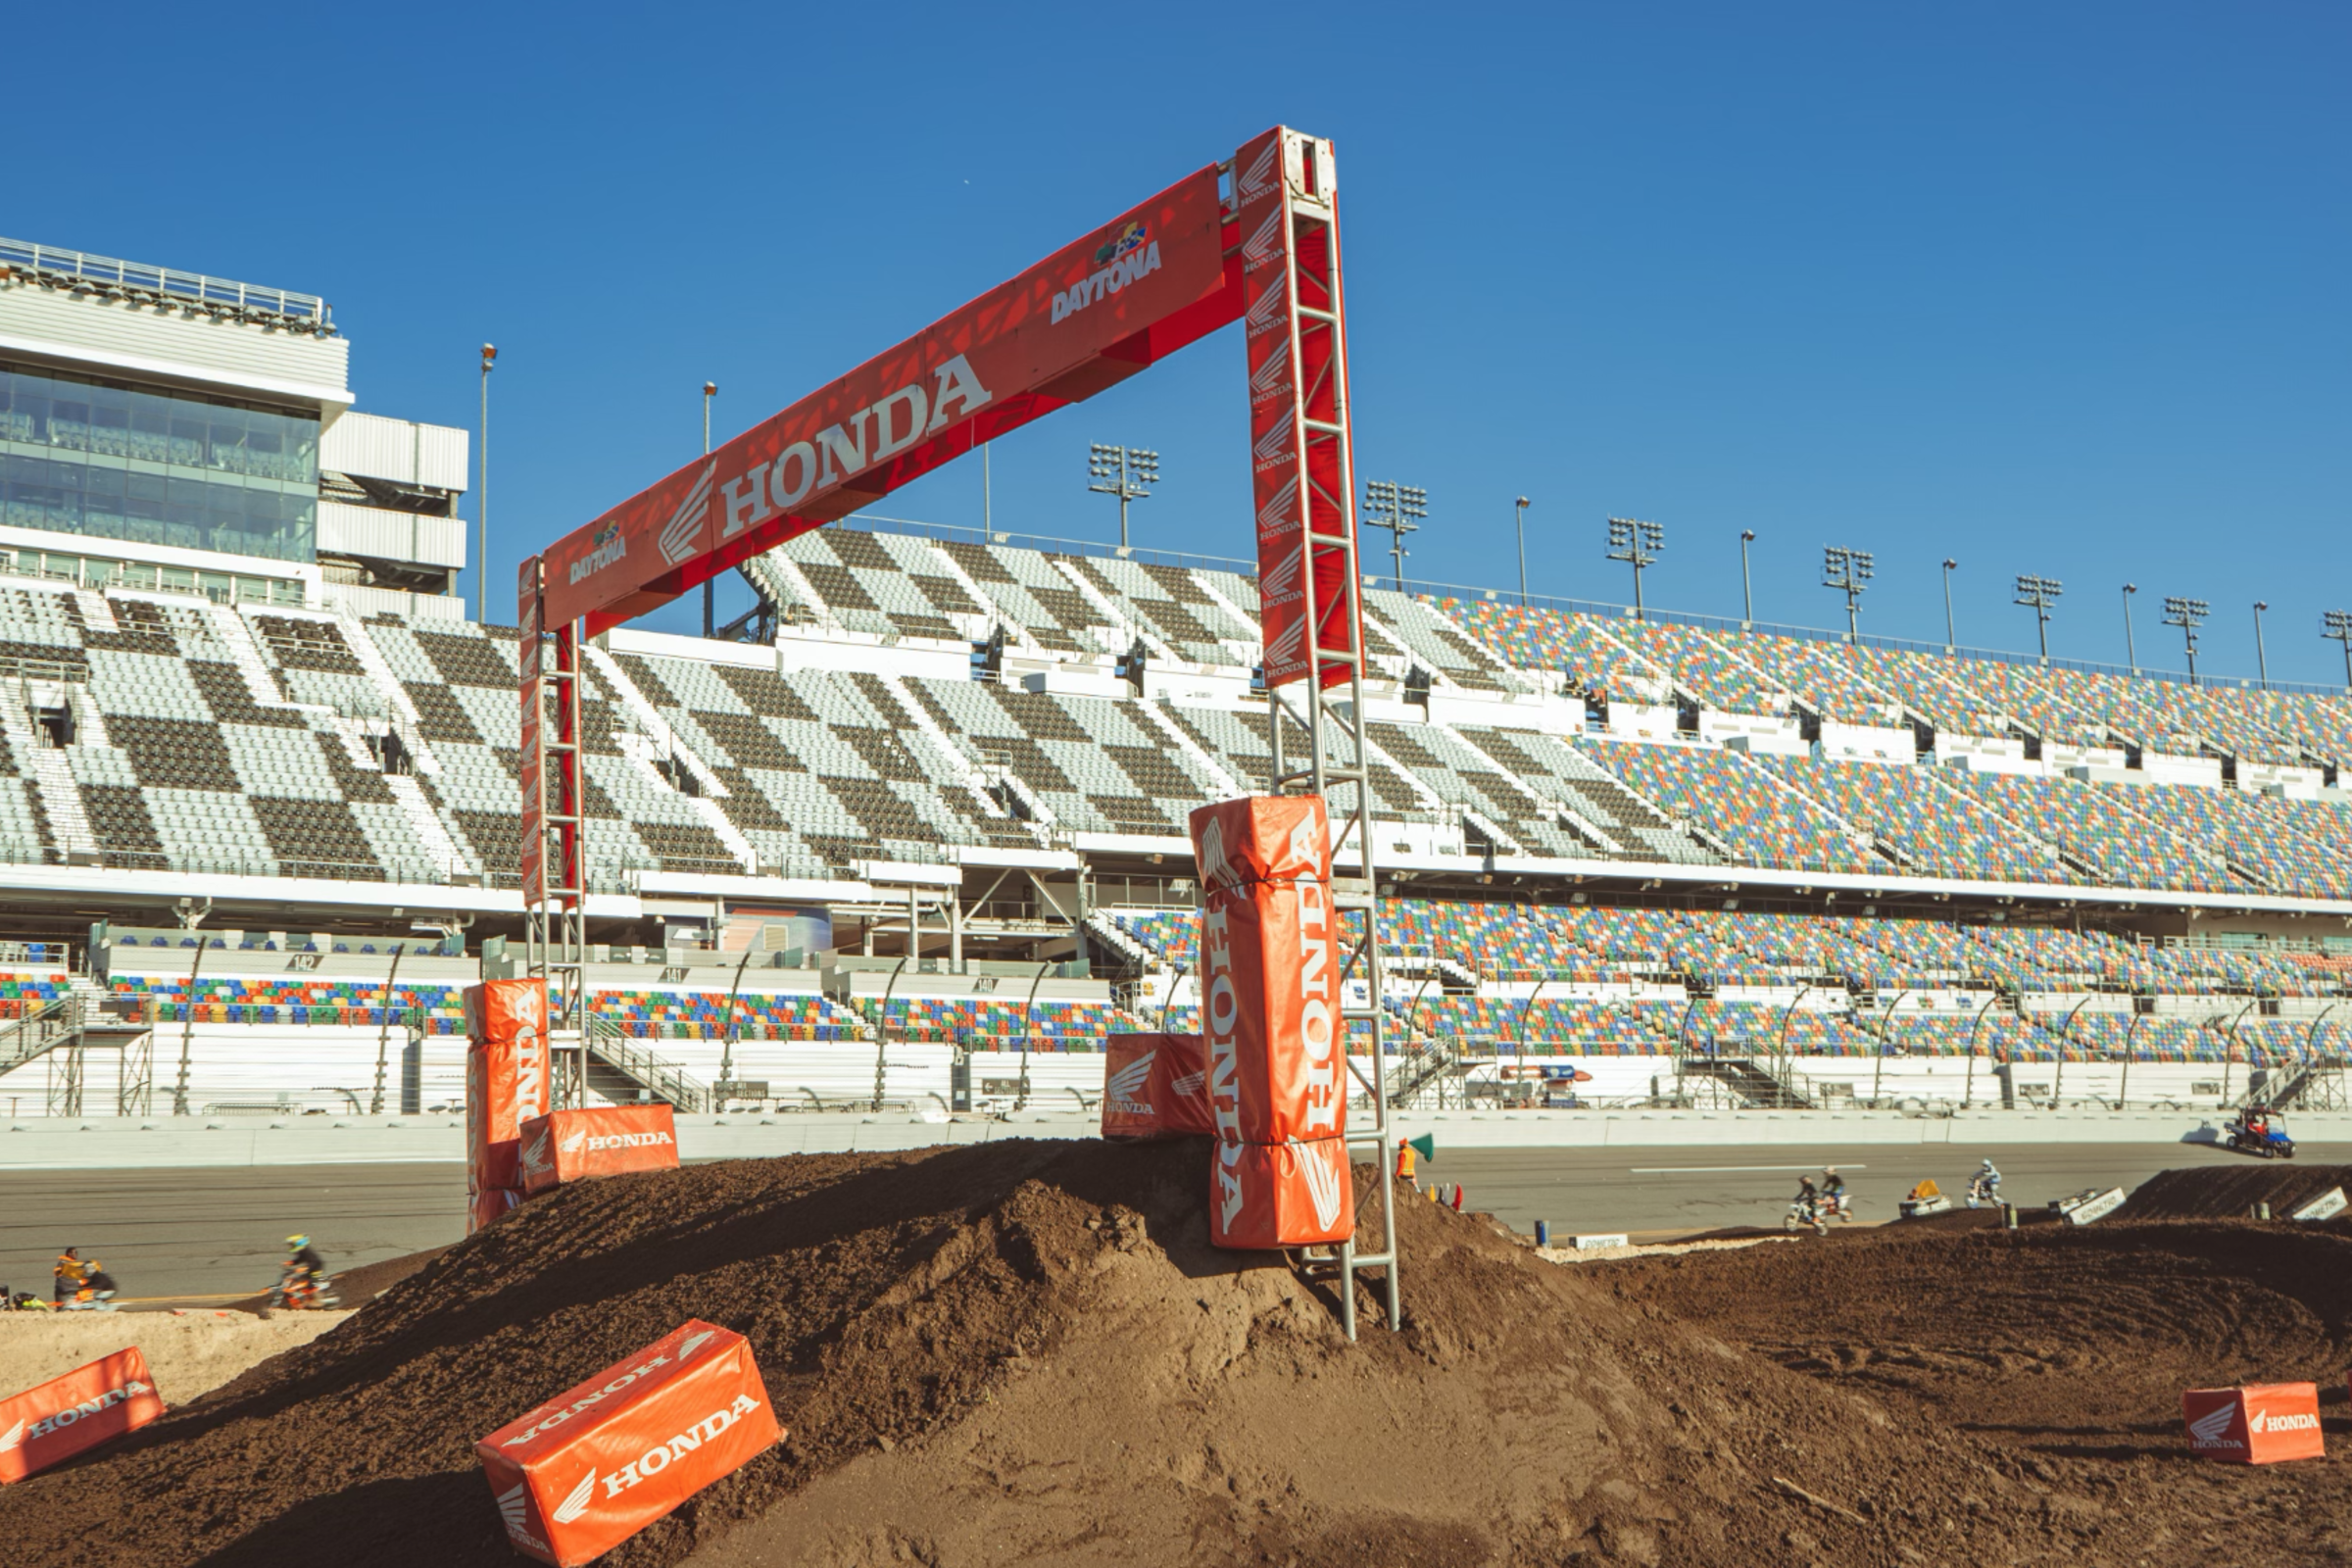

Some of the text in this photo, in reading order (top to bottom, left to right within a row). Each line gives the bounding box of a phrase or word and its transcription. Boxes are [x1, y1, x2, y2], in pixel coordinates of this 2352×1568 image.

[1241, 181, 1281, 208] HONDA
[1245, 248, 1285, 273] HONDA
[1051, 239, 1161, 325] DAYTONA
[1249, 314, 1289, 338] HONDA
[1252, 381, 1294, 406] HONDA
[721, 354, 992, 538] HONDA
[1255, 451, 1298, 473] HONDA
[1259, 520, 1301, 541] HONDA
[569, 536, 626, 585] DAYTONA
[1262, 589, 1304, 610] HONDA
[1266, 660, 1308, 679] HONDA
[295, 956, 315, 971] 142
[666, 968, 681, 982] 141
[1290, 806, 1336, 1133] HONDA
[979, 979, 993, 992] 140
[1205, 904, 1244, 1236] HONDA
[515, 984, 540, 1182] ONDA
[1105, 1101, 1155, 1114] HONDA
[586, 1131, 674, 1151] HONDA
[27, 1380, 151, 1440] HONDA
[502, 1355, 672, 1447] HONDA
[2266, 1413, 2319, 1432] HONDA
[601, 1394, 760, 1498] HONDA
[2192, 1439, 2244, 1449] HONDA
[507, 1527, 550, 1553] HONDA
